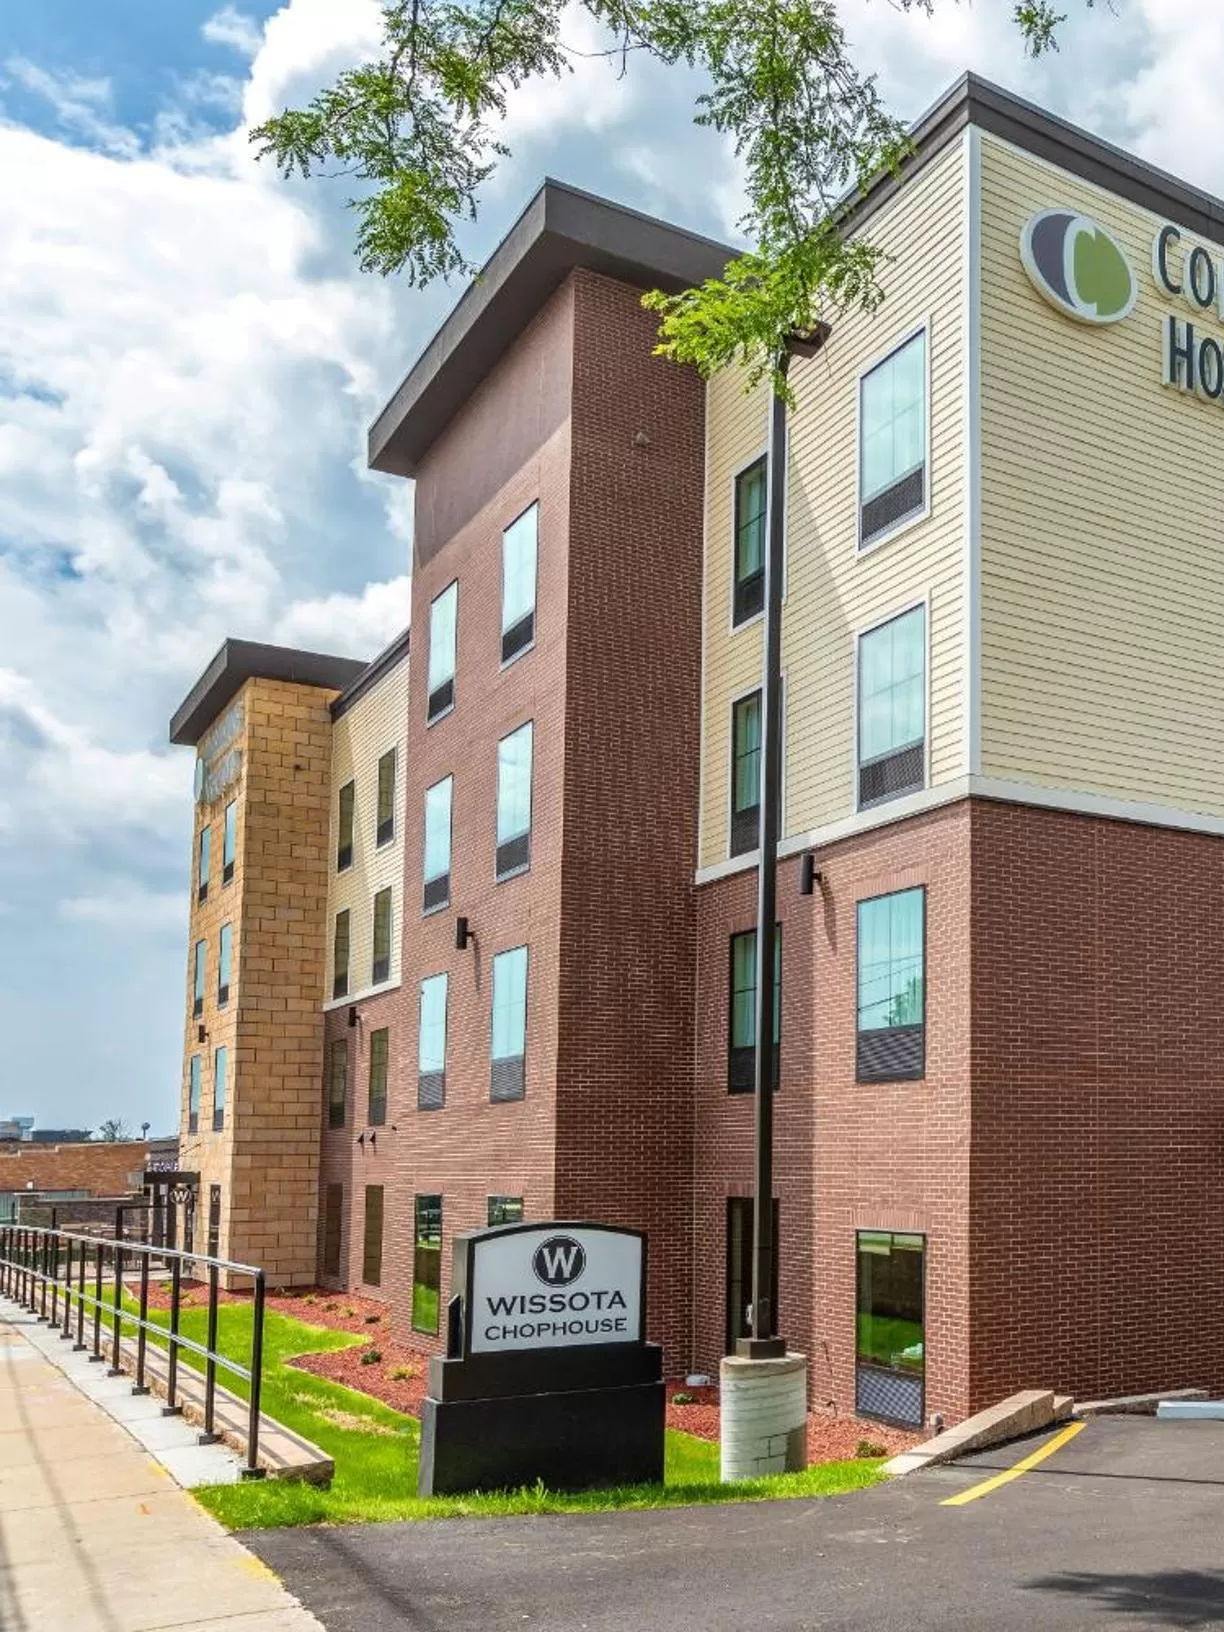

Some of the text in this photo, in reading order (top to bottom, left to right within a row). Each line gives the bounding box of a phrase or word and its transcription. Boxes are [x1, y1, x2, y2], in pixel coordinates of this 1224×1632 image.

[542, 1246, 578, 1278] W
[486, 1290, 627, 1316] WISSOTA
[484, 1317, 627, 1341] CHOPHOUSE
